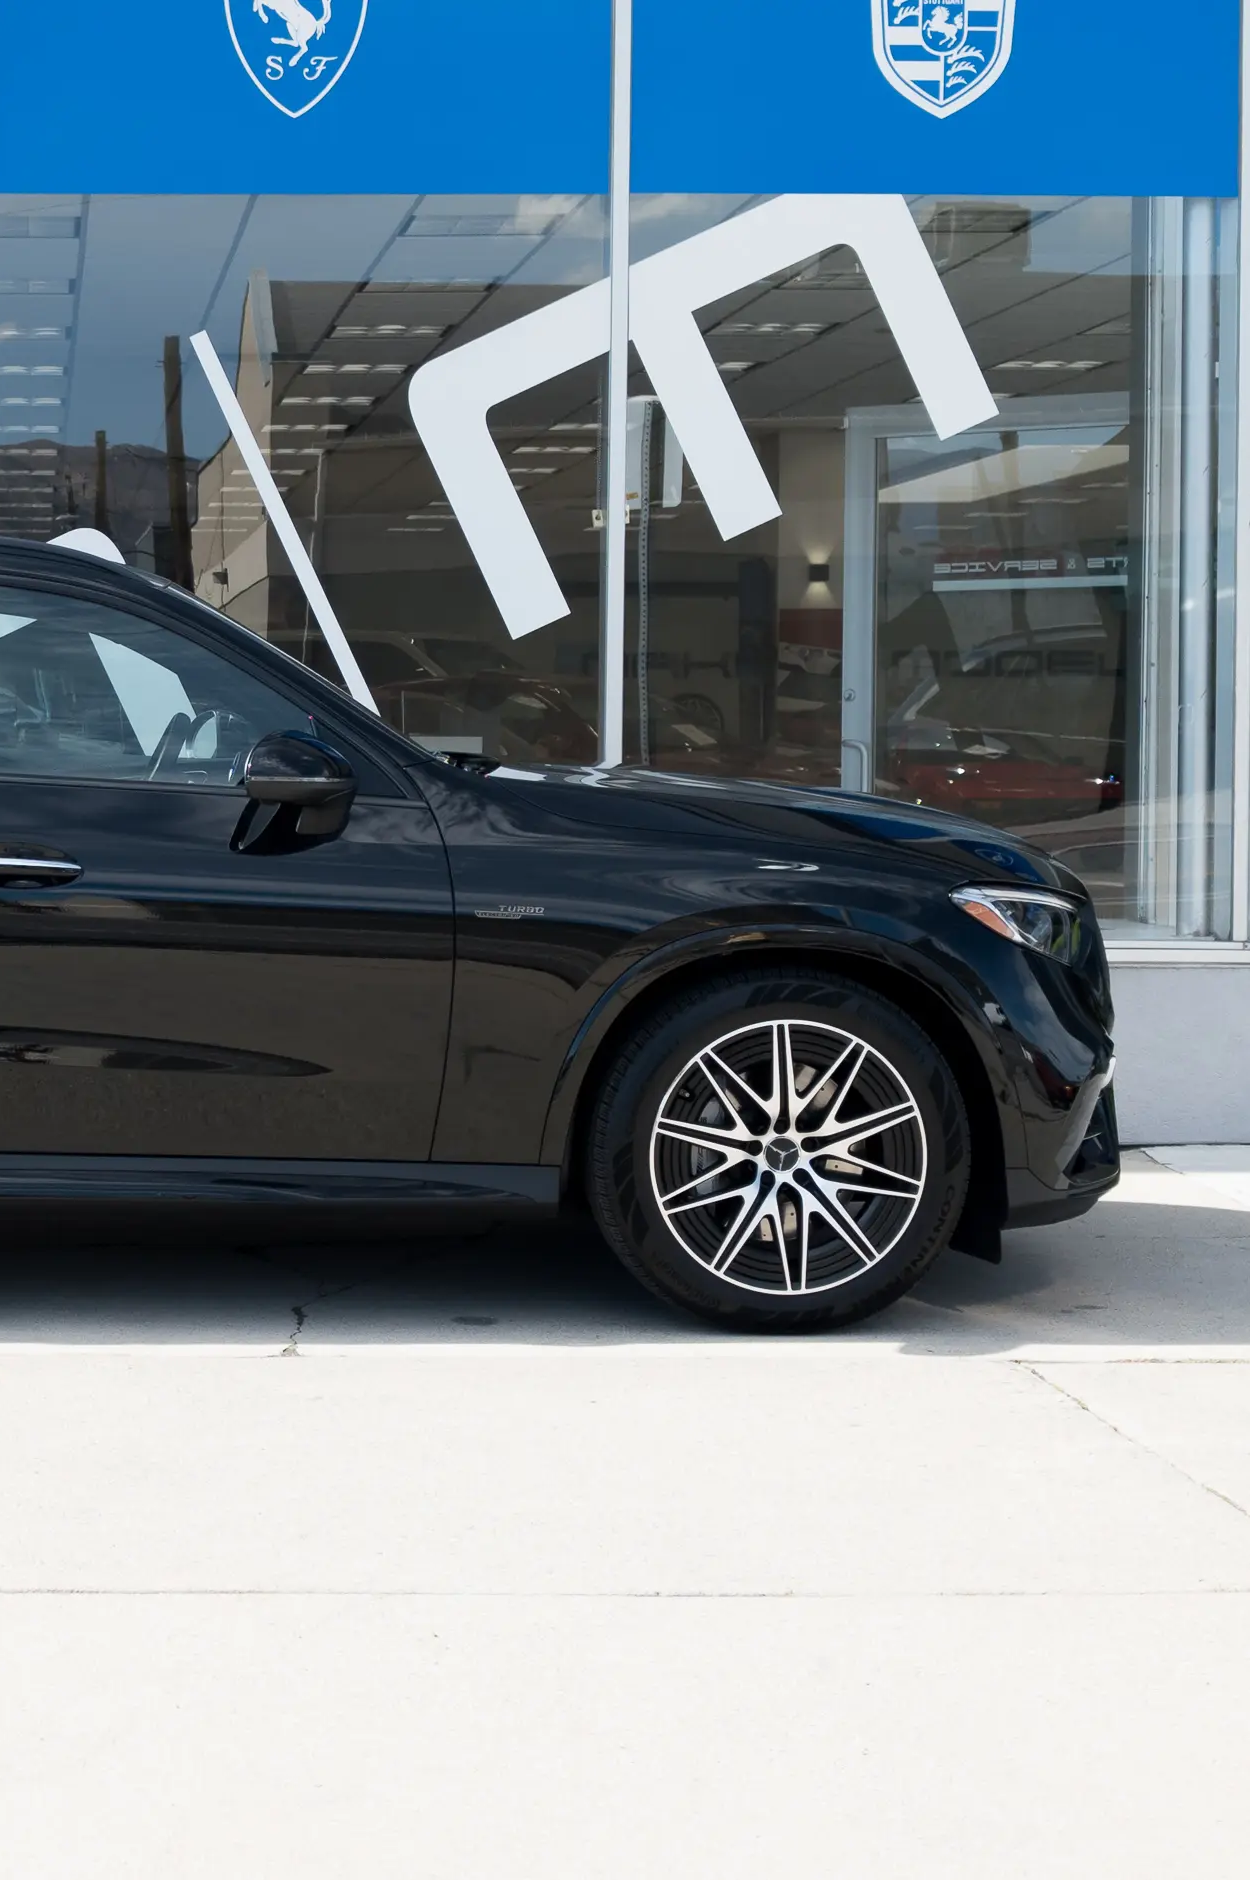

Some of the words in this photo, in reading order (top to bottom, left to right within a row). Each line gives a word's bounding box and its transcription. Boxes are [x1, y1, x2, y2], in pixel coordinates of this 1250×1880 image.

[265, 55, 285, 81] S
[302, 55, 339, 81] F
[498, 905, 545, 914] TURBO
